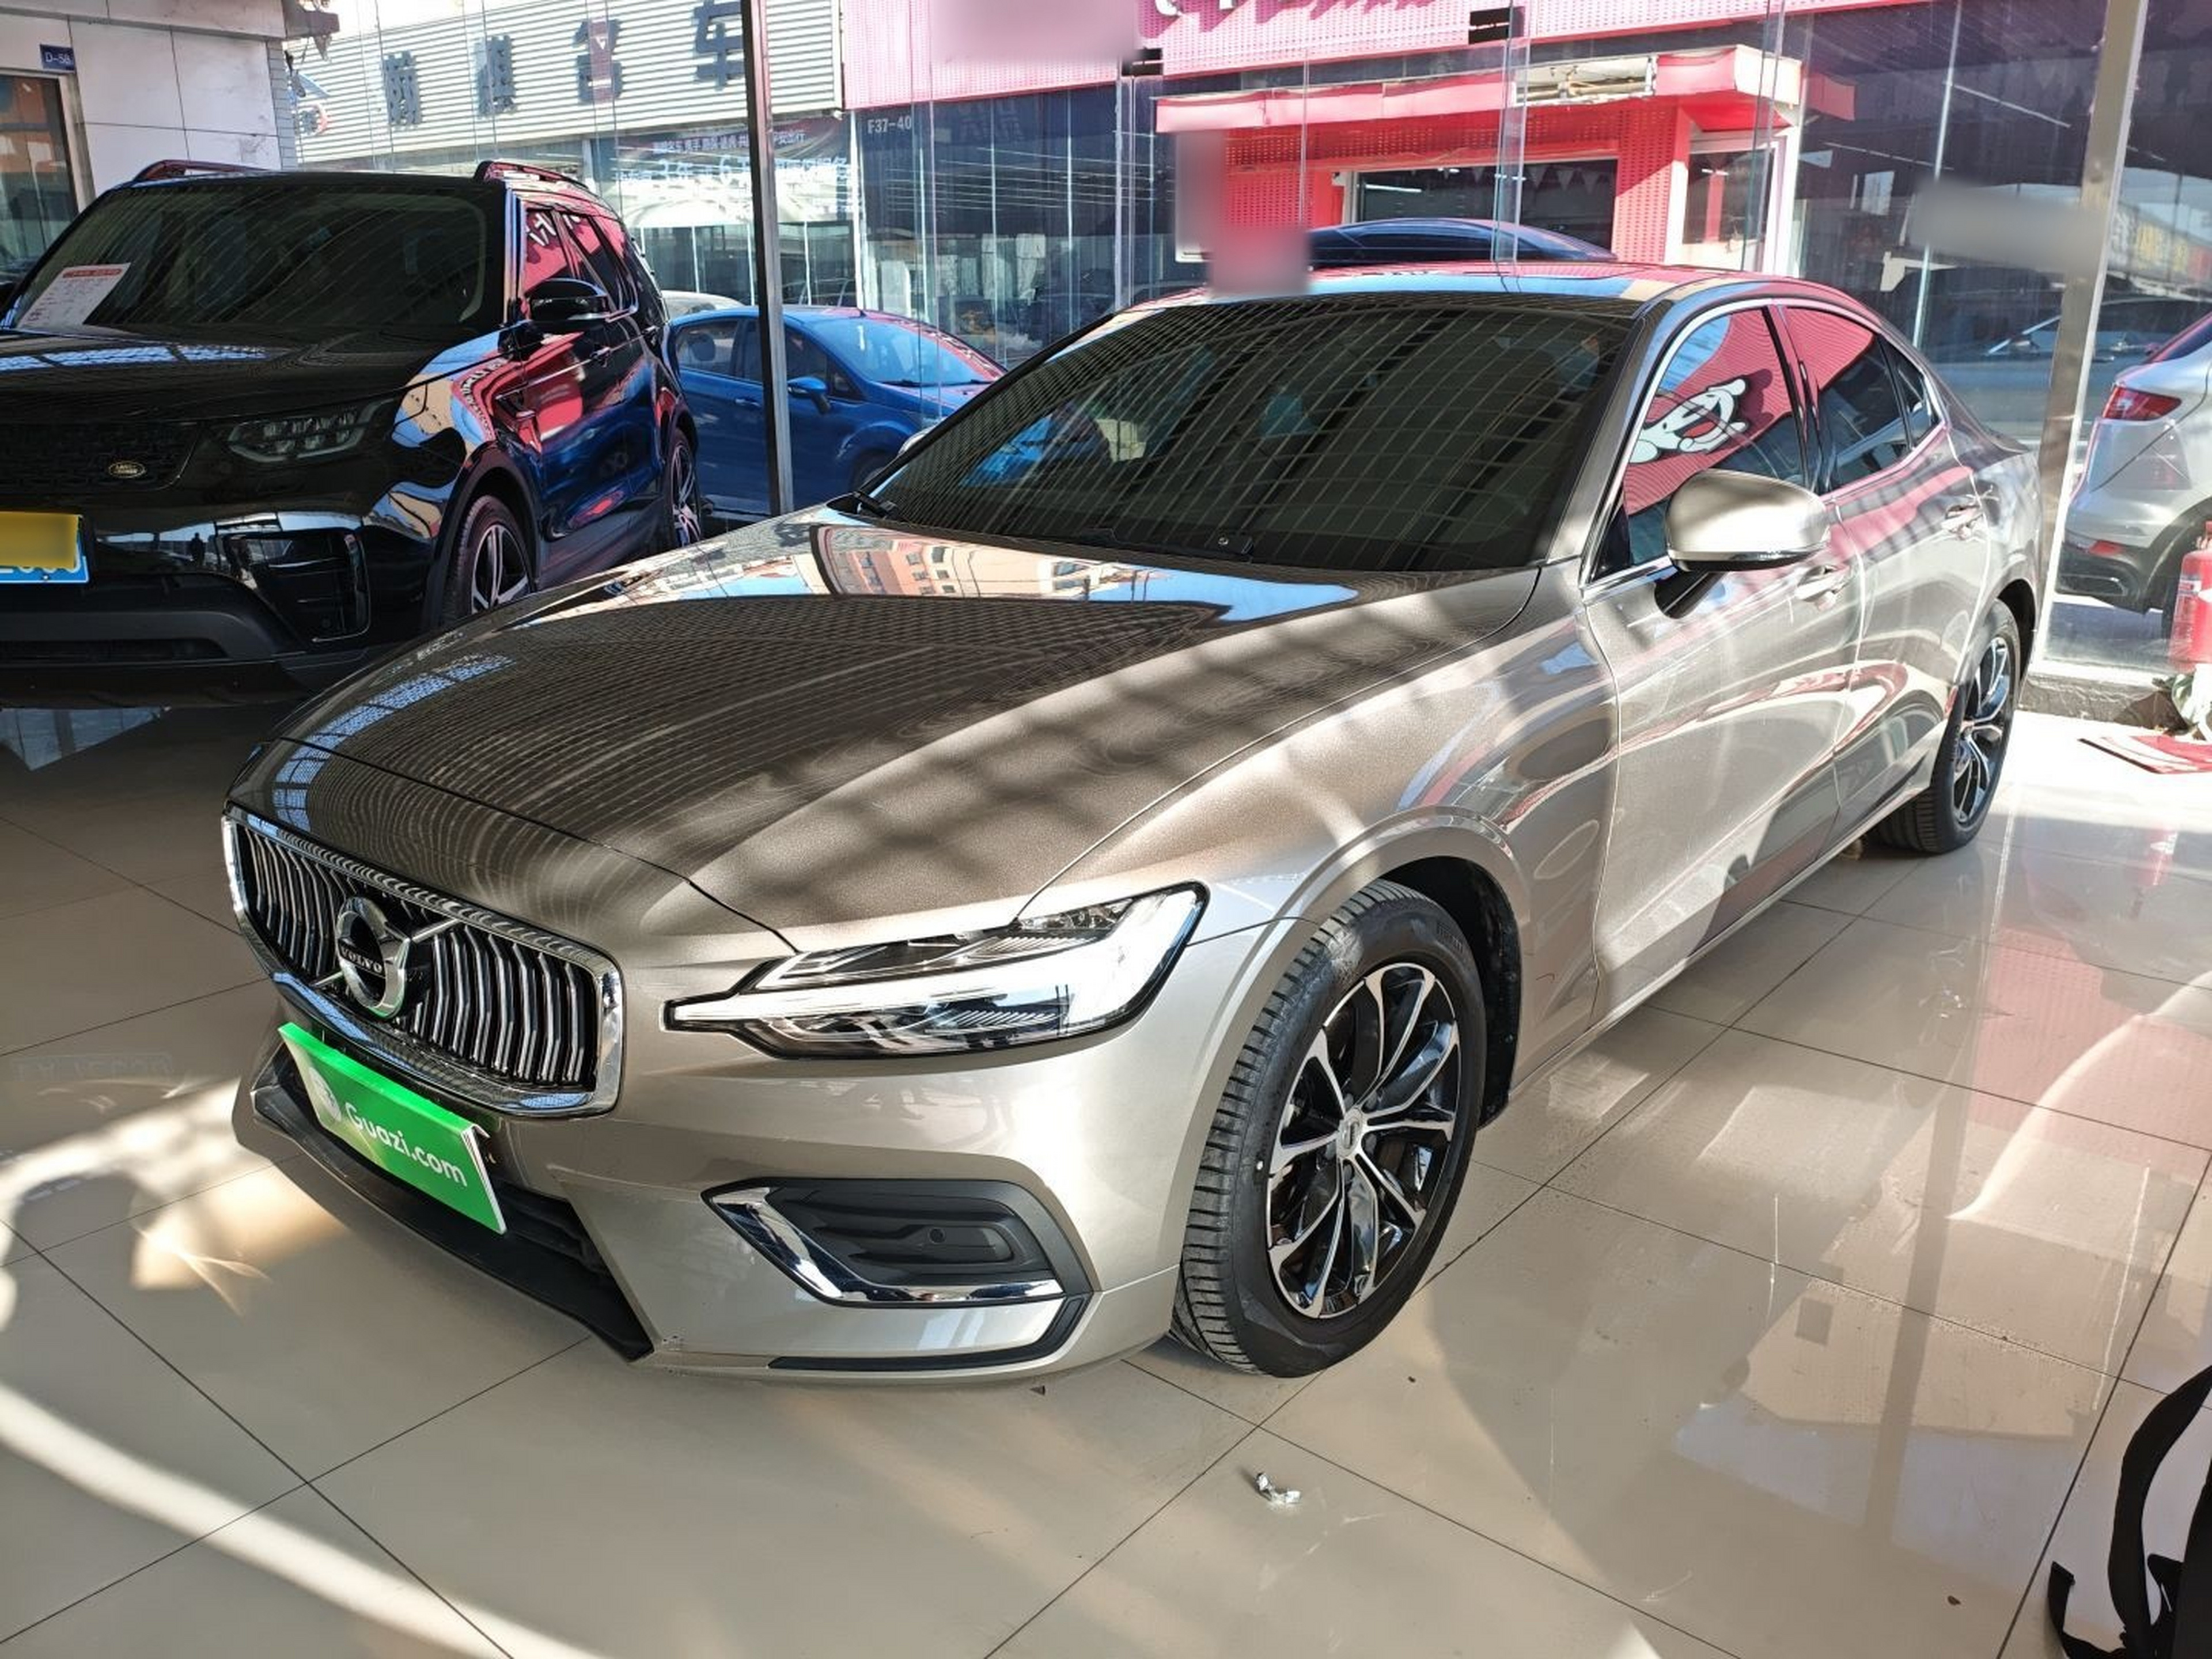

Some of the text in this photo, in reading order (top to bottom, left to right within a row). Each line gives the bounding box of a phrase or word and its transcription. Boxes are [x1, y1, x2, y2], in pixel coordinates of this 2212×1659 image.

[868, 116, 912, 134] F37-40
[340, 946, 382, 974] VOLVO
[346, 1101, 468, 1187] Guazi.com
